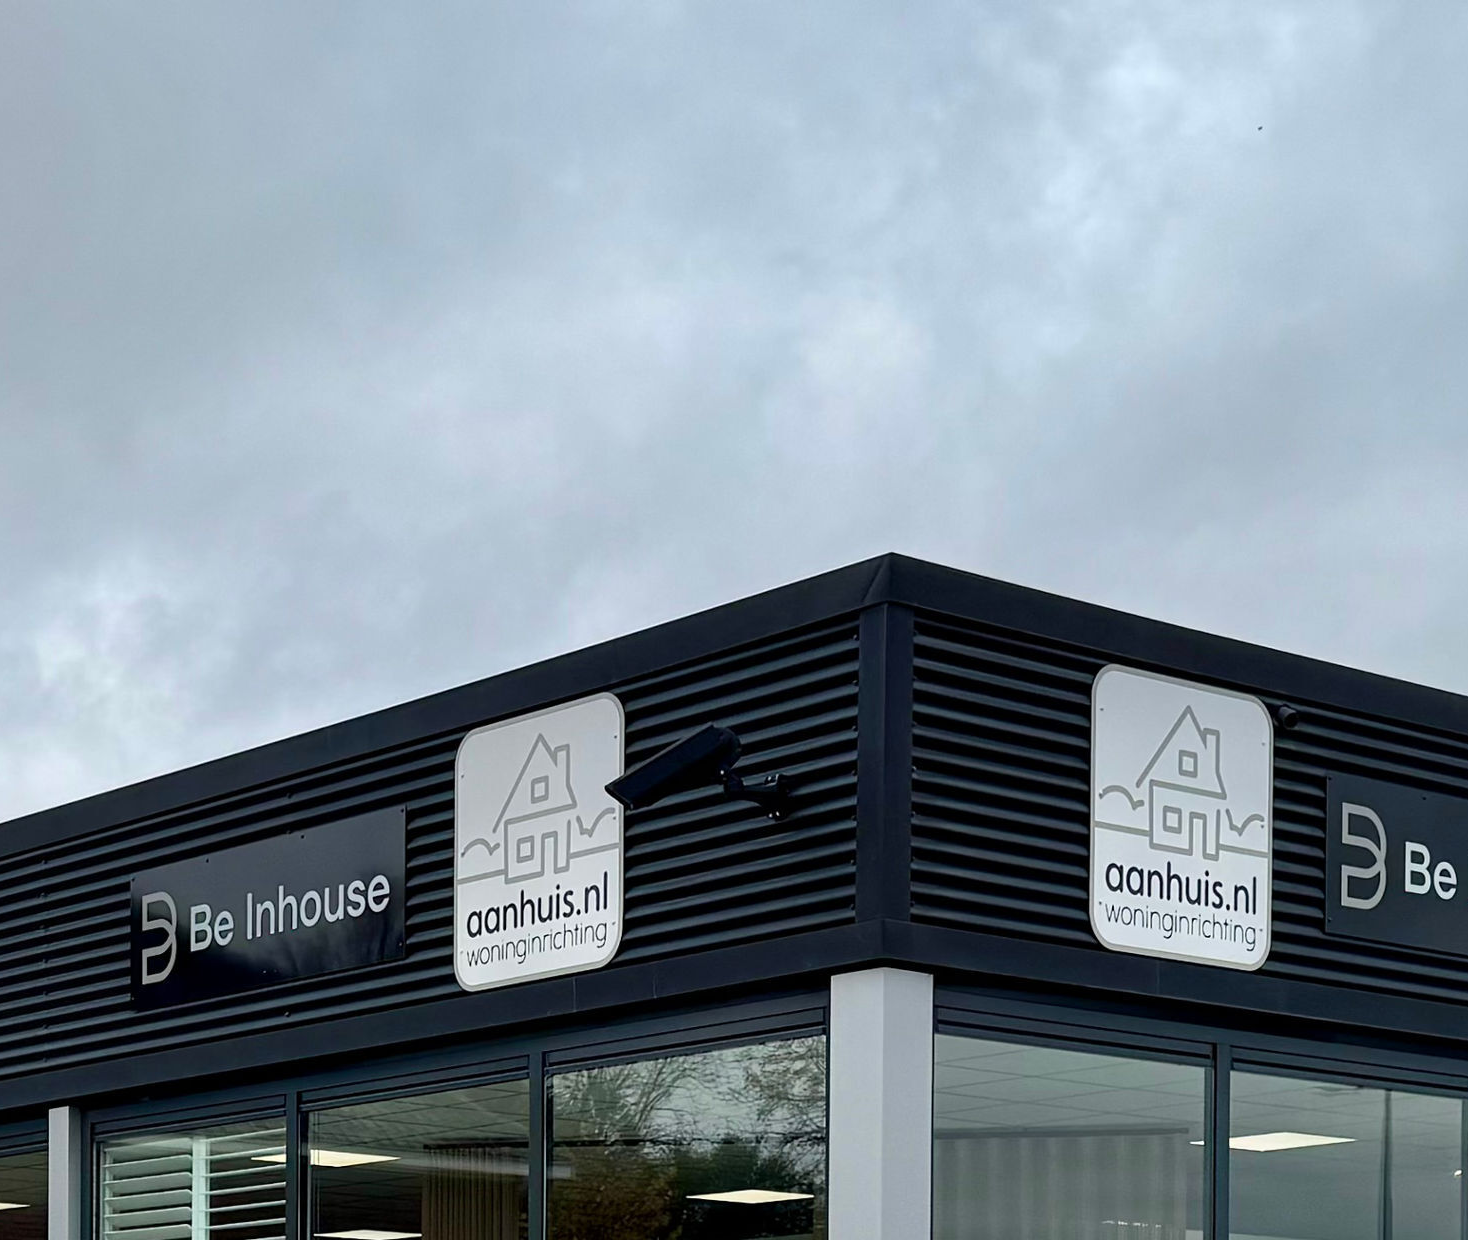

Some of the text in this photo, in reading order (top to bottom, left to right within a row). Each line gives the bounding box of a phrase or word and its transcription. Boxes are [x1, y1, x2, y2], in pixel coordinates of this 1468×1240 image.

[1105, 860, 1257, 915] aanhuis.nl
[1404, 840, 1458, 900] Be
[190, 903, 235, 952] Be
[246, 874, 391, 941] Inhouse
[466, 870, 608, 938] aanhuis.nl
[1105, 903, 1256, 951] woninginrichting
[466, 921, 608, 967] woninginrichting
